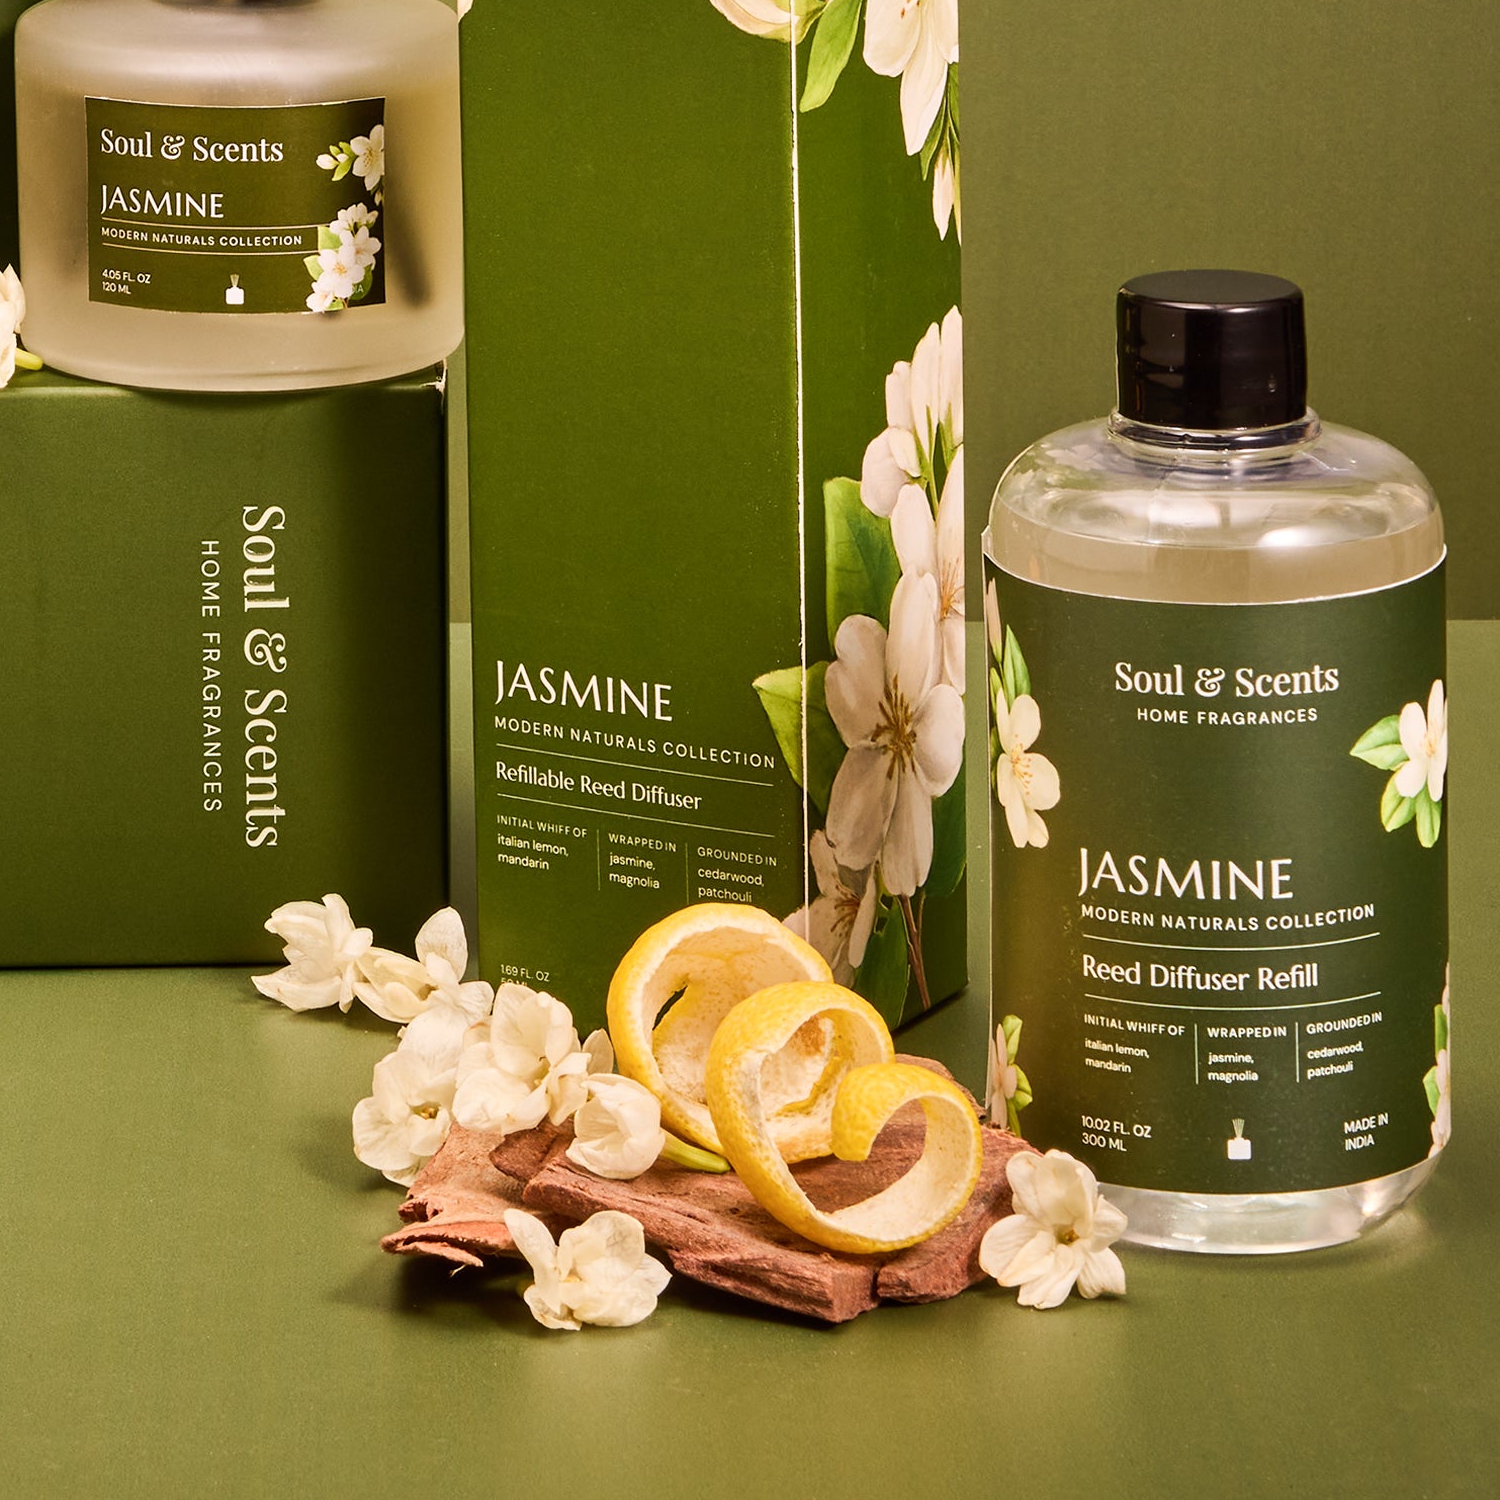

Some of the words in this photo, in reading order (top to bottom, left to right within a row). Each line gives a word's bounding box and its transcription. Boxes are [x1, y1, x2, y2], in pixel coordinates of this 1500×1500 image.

[101, 129, 152, 157] Soul
[161, 135, 186, 160] &
[193, 136, 284, 163] Scents
[101, 184, 224, 218] JASMINE
[101, 227, 148, 242] MODERN
[152, 232, 215, 246] NATURALS
[220, 235, 302, 247] COLLECTION
[102, 281, 117, 292] 120
[118, 284, 132, 295] ML
[137, 273, 151, 284] OZ
[242, 505, 290, 612] Soul
[201, 541, 221, 618] HOME
[243, 628, 287, 673] &
[495, 660, 673, 721] JASMINE
[1115, 661, 1185, 696] Soul
[1195, 667, 1226, 698] &
[1235, 664, 1340, 698] Scents
[202, 632, 222, 812] FRAGRANCES
[1137, 708, 1189, 724] HOME
[1197, 707, 1318, 726] FRAGRANCES
[494, 715, 564, 739] MODERN
[571, 728, 656, 753] NATURALS
[663, 741, 775, 769] COLLECTION
[244, 689, 288, 848] Scents
[496, 761, 575, 791] Refillable
[581, 775, 625, 800] Reed
[632, 783, 702, 810] Diffuser
[496, 814, 534, 831] INITIAL
[536, 821, 571, 836] WHIFF
[572, 827, 588, 838] OF
[497, 834, 530, 850] italian
[532, 838, 569, 857] lemon,
[608, 833, 664, 851] WRAPPED
[665, 842, 677, 853] IN
[498, 852, 550, 870] mandarin
[609, 852, 656, 871] jasmine,
[697, 846, 764, 865] GROUNDED
[765, 856, 777, 867] IN
[609, 872, 660, 890] magnolia
[698, 866, 764, 888] cedarwood,
[1078, 847, 1294, 900] JASMINE
[698, 887, 752, 903] patchouli
[1081, 904, 1154, 927] MODERN
[1161, 915, 1259, 931] NATURALS
[1265, 904, 1375, 931] COLLECTION
[520, 967, 534, 979] FL.
[536, 970, 550, 982] OZ
[1083, 954, 1141, 985] Reed
[1150, 964, 1250, 991] Diffuser
[1258, 963, 1318, 990] Refill
[1084, 1013, 1125, 1031] INITIAL
[1126, 1020, 1165, 1035] WHIFF
[1167, 1025, 1185, 1036] OF
[1207, 1027, 1272, 1039] WRAPPED
[1273, 1026, 1287, 1038] IN
[1306, 1014, 1371, 1035] GROUNDED
[1371, 1011, 1383, 1024] IN
[1084, 1037, 1114, 1053] italian
[1115, 1041, 1150, 1059] lemon,
[1207, 1051, 1255, 1066] jasmine,
[1307, 1041, 1364, 1060] cedarwood,
[1085, 1056, 1132, 1073] mandarin
[1307, 1060, 1354, 1080] patchouli
[1208, 1070, 1259, 1083] magnolia
[1081, 1115, 1111, 1133] 10.02
[1113, 1121, 1130, 1136] FL.
[1133, 1124, 1152, 1139] OZ
[1344, 1116, 1376, 1135] MADE
[1377, 1112, 1389, 1127] IN
[1082, 1132, 1107, 1149] 300
[1108, 1137, 1127, 1152] ML
[1344, 1133, 1375, 1151] INDIA
